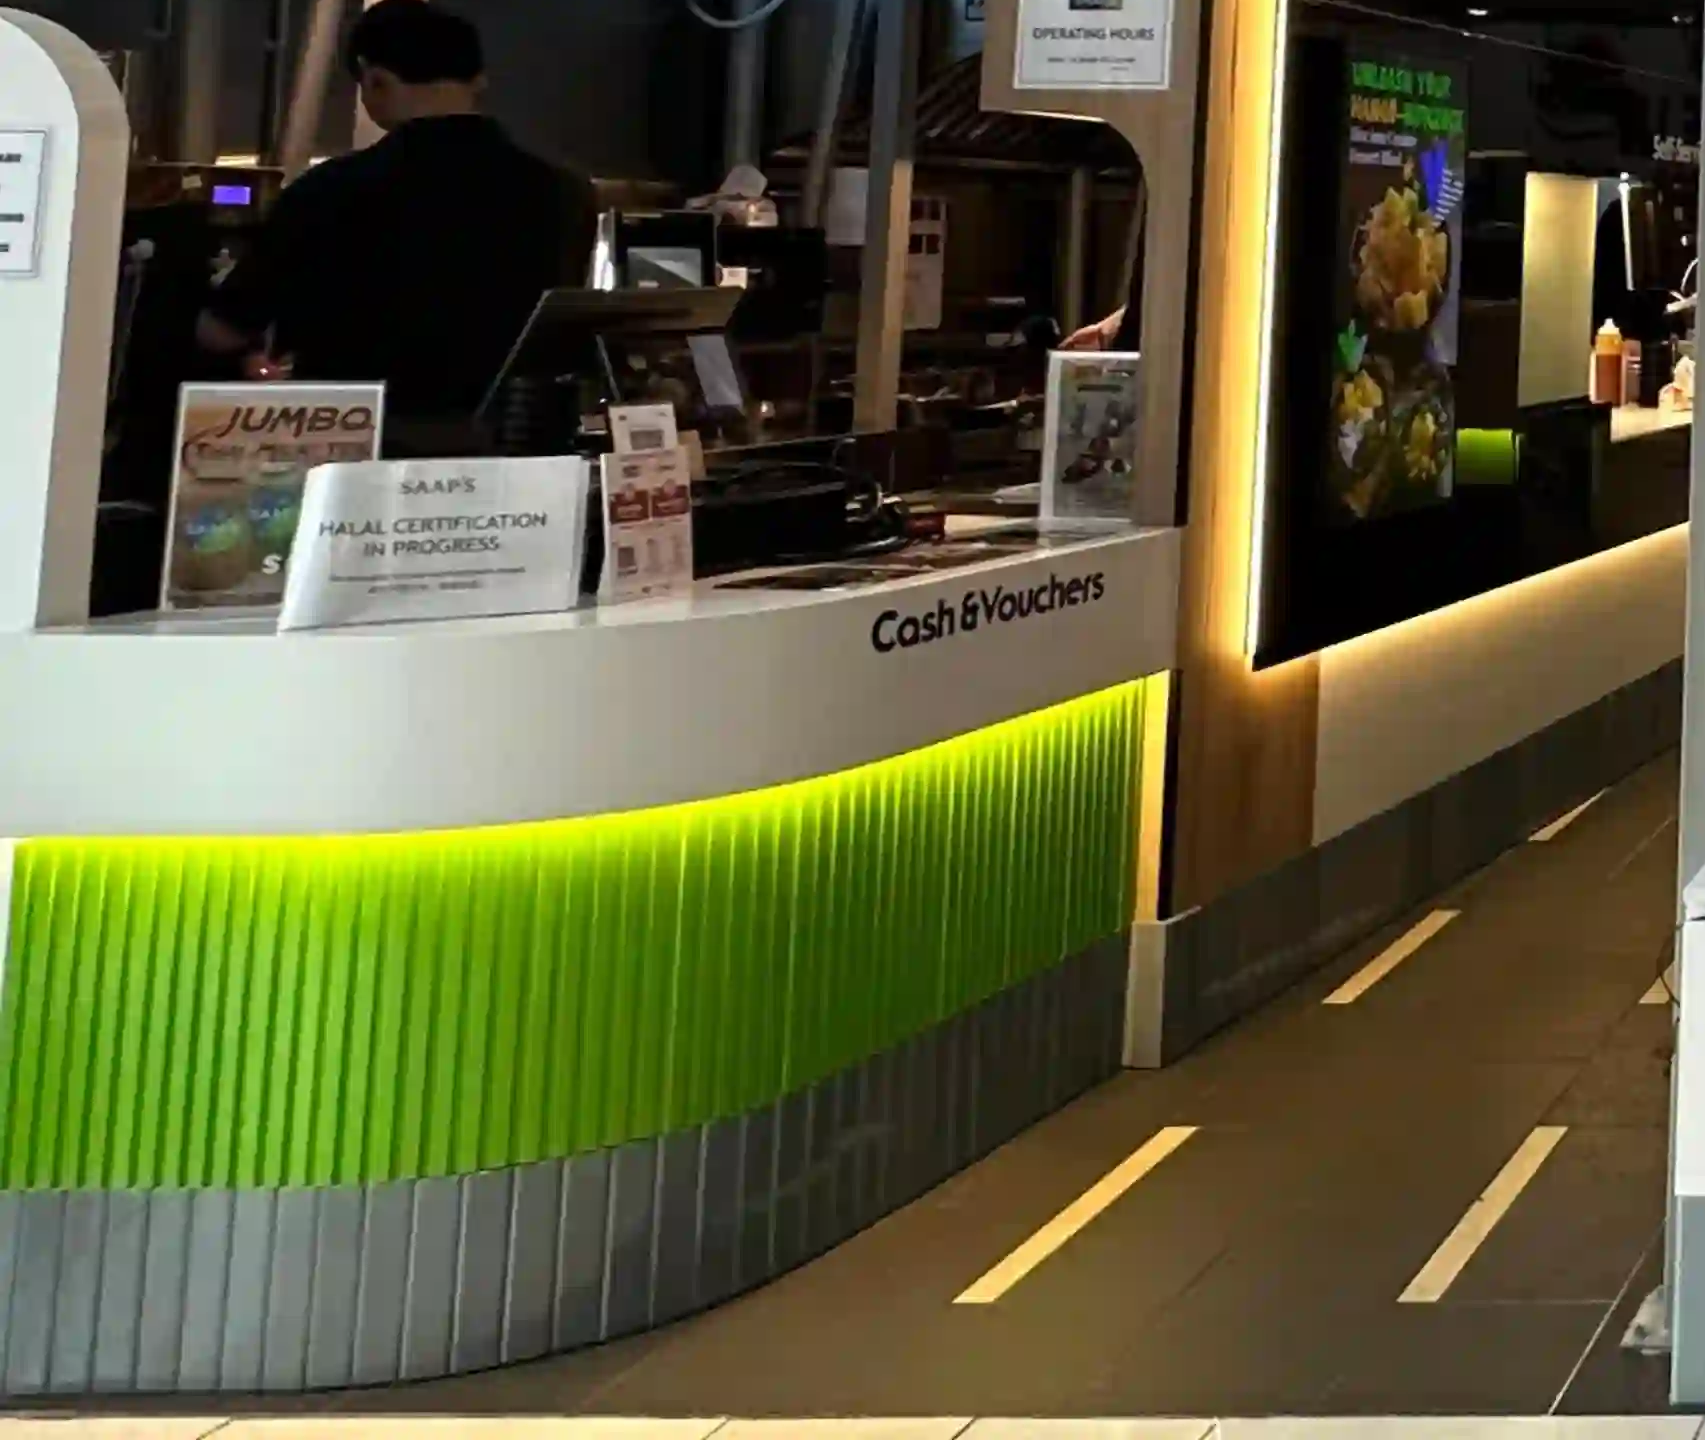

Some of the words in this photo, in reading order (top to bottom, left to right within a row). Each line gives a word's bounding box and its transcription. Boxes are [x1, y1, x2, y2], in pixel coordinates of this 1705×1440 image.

[1032, 26, 1107, 41] OPERATING
[1110, 27, 1154, 41] HOURS
[212, 405, 377, 438] JUMBO
[399, 476, 476, 495] SAAP'S
[319, 519, 386, 537] HALAL
[393, 513, 547, 535] CERTIFICATION
[363, 538, 385, 557] IN
[391, 536, 501, 555] PROGRESS
[871, 598, 965, 654] Cash
[960, 591, 980, 631] &
[980, 570, 1106, 625] Vouchers
